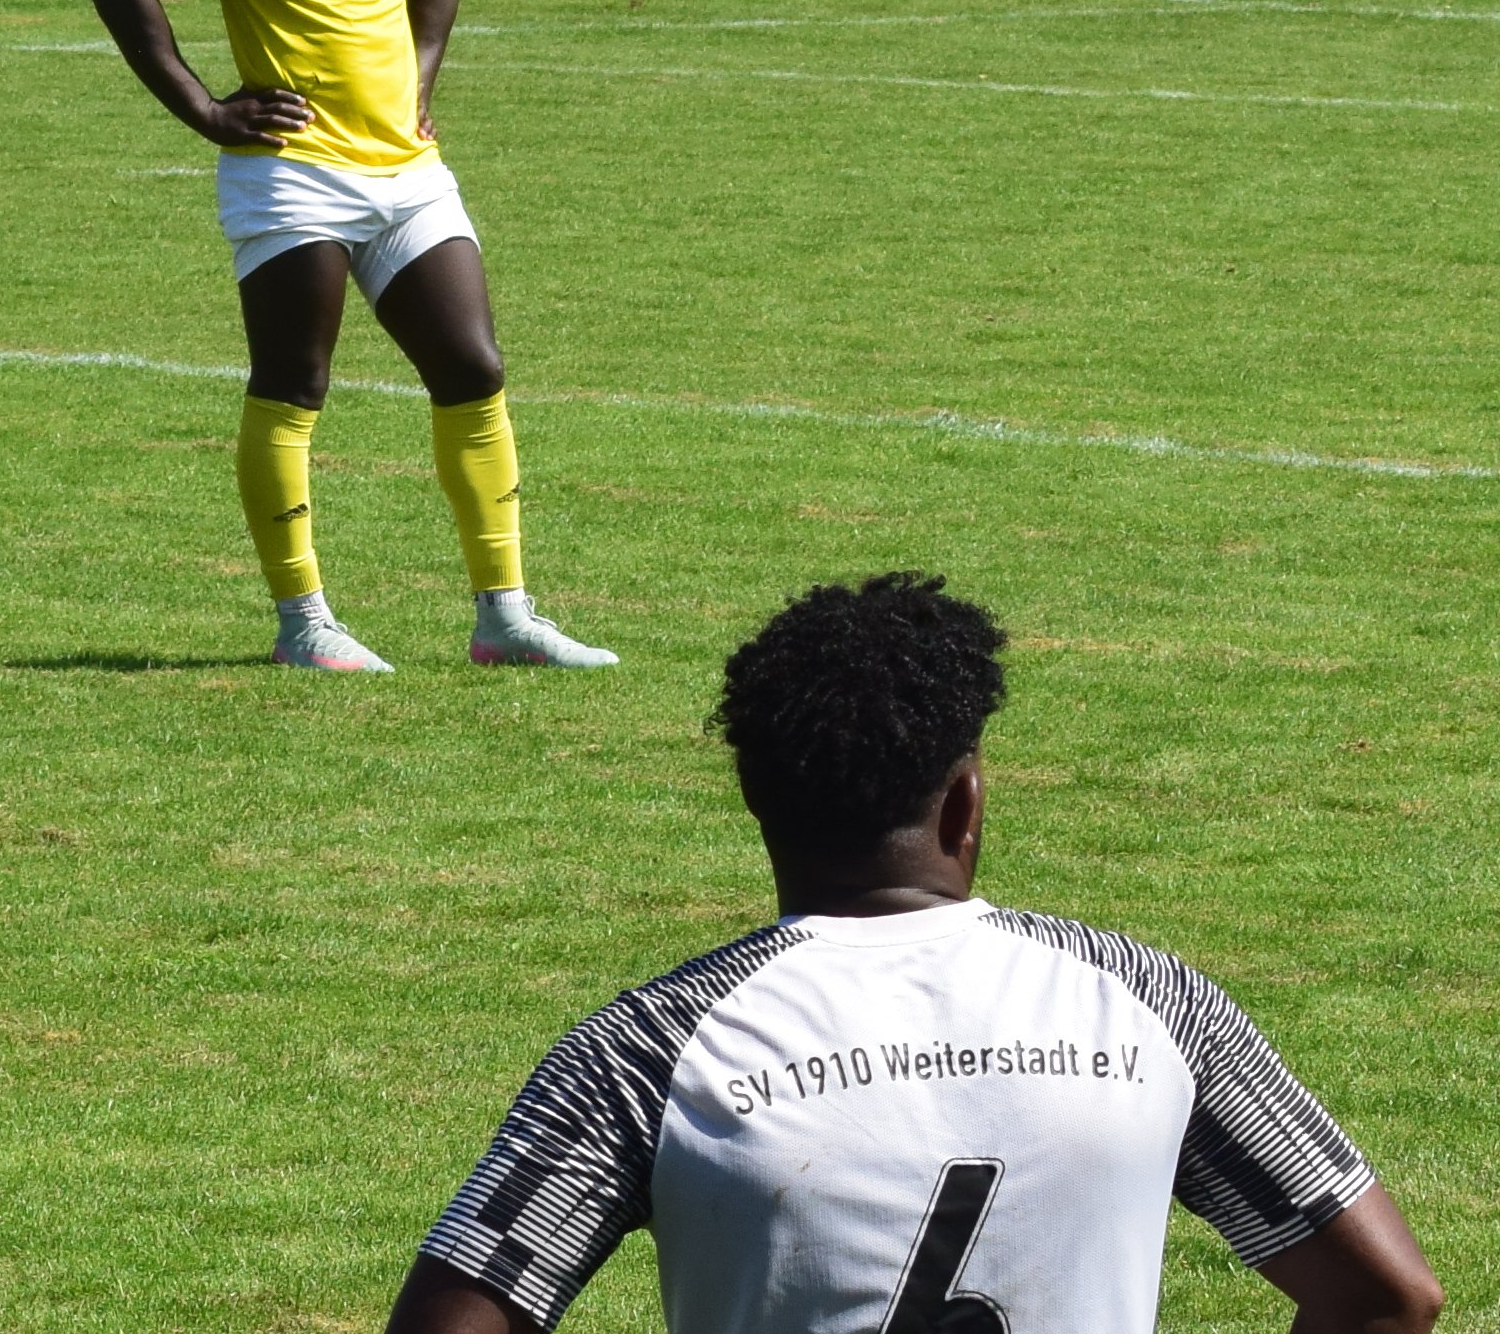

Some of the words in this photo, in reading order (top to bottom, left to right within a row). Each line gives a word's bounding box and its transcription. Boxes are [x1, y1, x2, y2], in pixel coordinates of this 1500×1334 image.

[727, 1069, 773, 1116] SV
[785, 1047, 873, 1100] 1910
[880, 1039, 1080, 1081] Weiterstadt
[1091, 1044, 1144, 1084] e.V.
